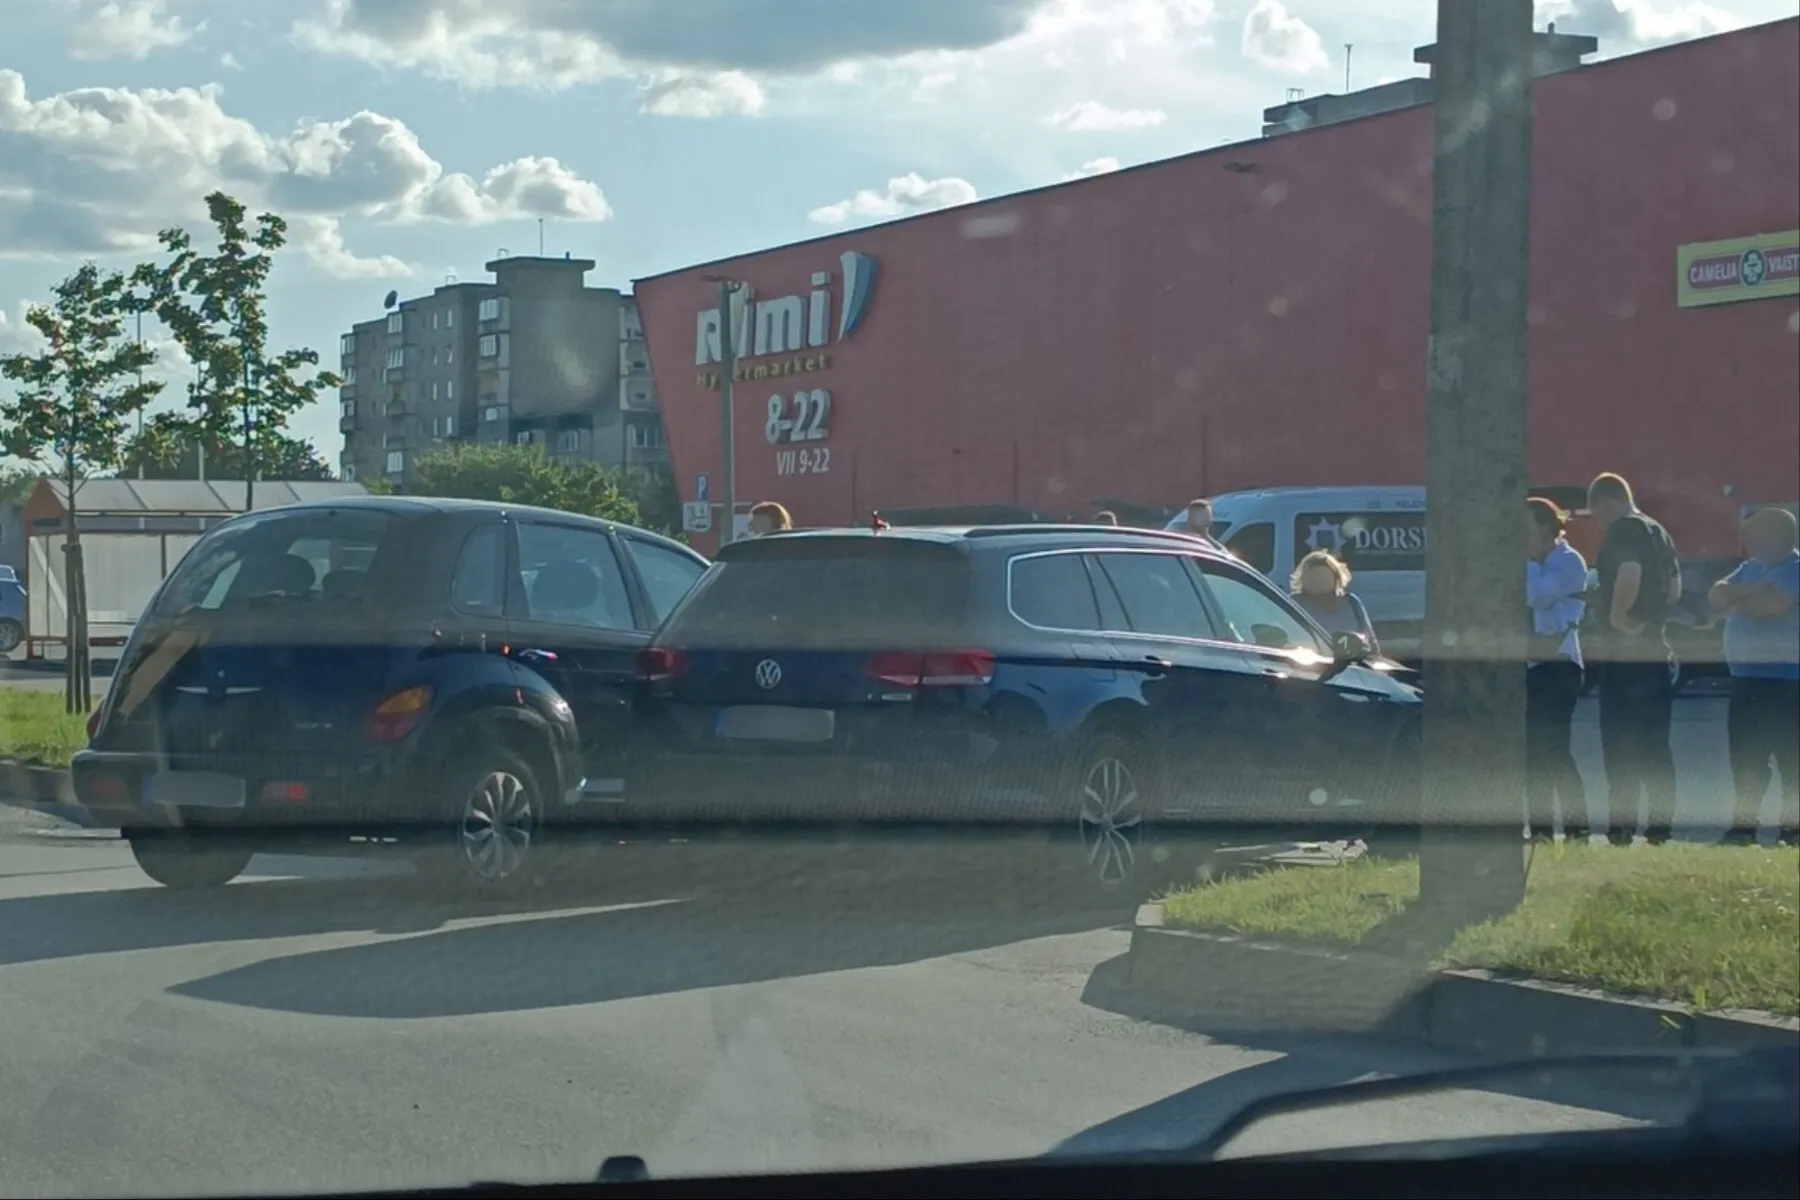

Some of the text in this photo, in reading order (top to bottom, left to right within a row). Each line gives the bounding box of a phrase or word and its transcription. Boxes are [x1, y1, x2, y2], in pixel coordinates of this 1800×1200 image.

[1690, 261, 1737, 283] CAMELIA
[696, 272, 831, 365] Rimi
[697, 353, 827, 389] Hyermarket
[766, 388, 830, 444] 8-22
[777, 448, 829, 475] VII 9-22
[698, 475, 707, 499] P
